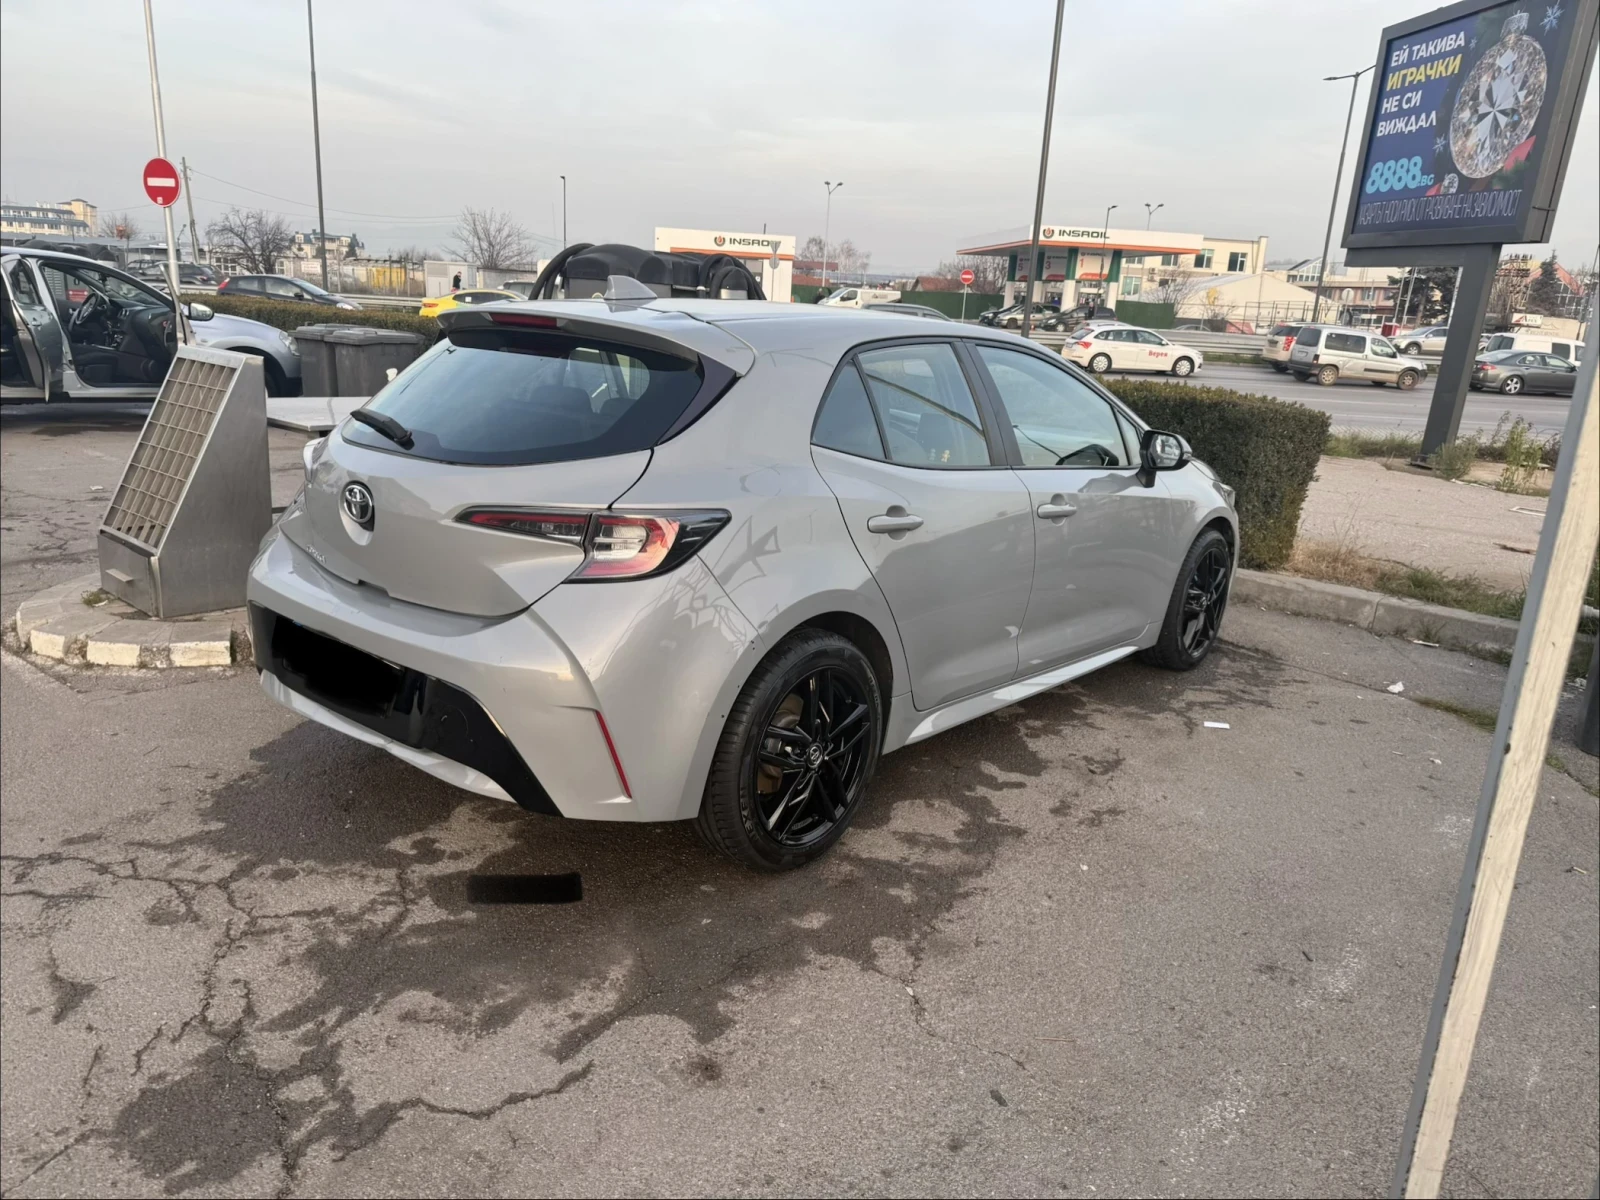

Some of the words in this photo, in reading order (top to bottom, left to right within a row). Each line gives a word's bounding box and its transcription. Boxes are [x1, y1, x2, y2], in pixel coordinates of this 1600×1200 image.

[1391, 45, 1409, 66] ЕЙ
[1411, 31, 1466, 61] ТАКИВА
[1387, 54, 1463, 90] ИГРАЧКИ
[1381, 96, 1399, 115] НЕ
[1402, 90, 1422, 110] СИ
[1376, 111, 1436, 137] ВИЖДАЛ
[729, 237, 771, 247] INSAO
[1058, 229, 1110, 239] INSAOIL
